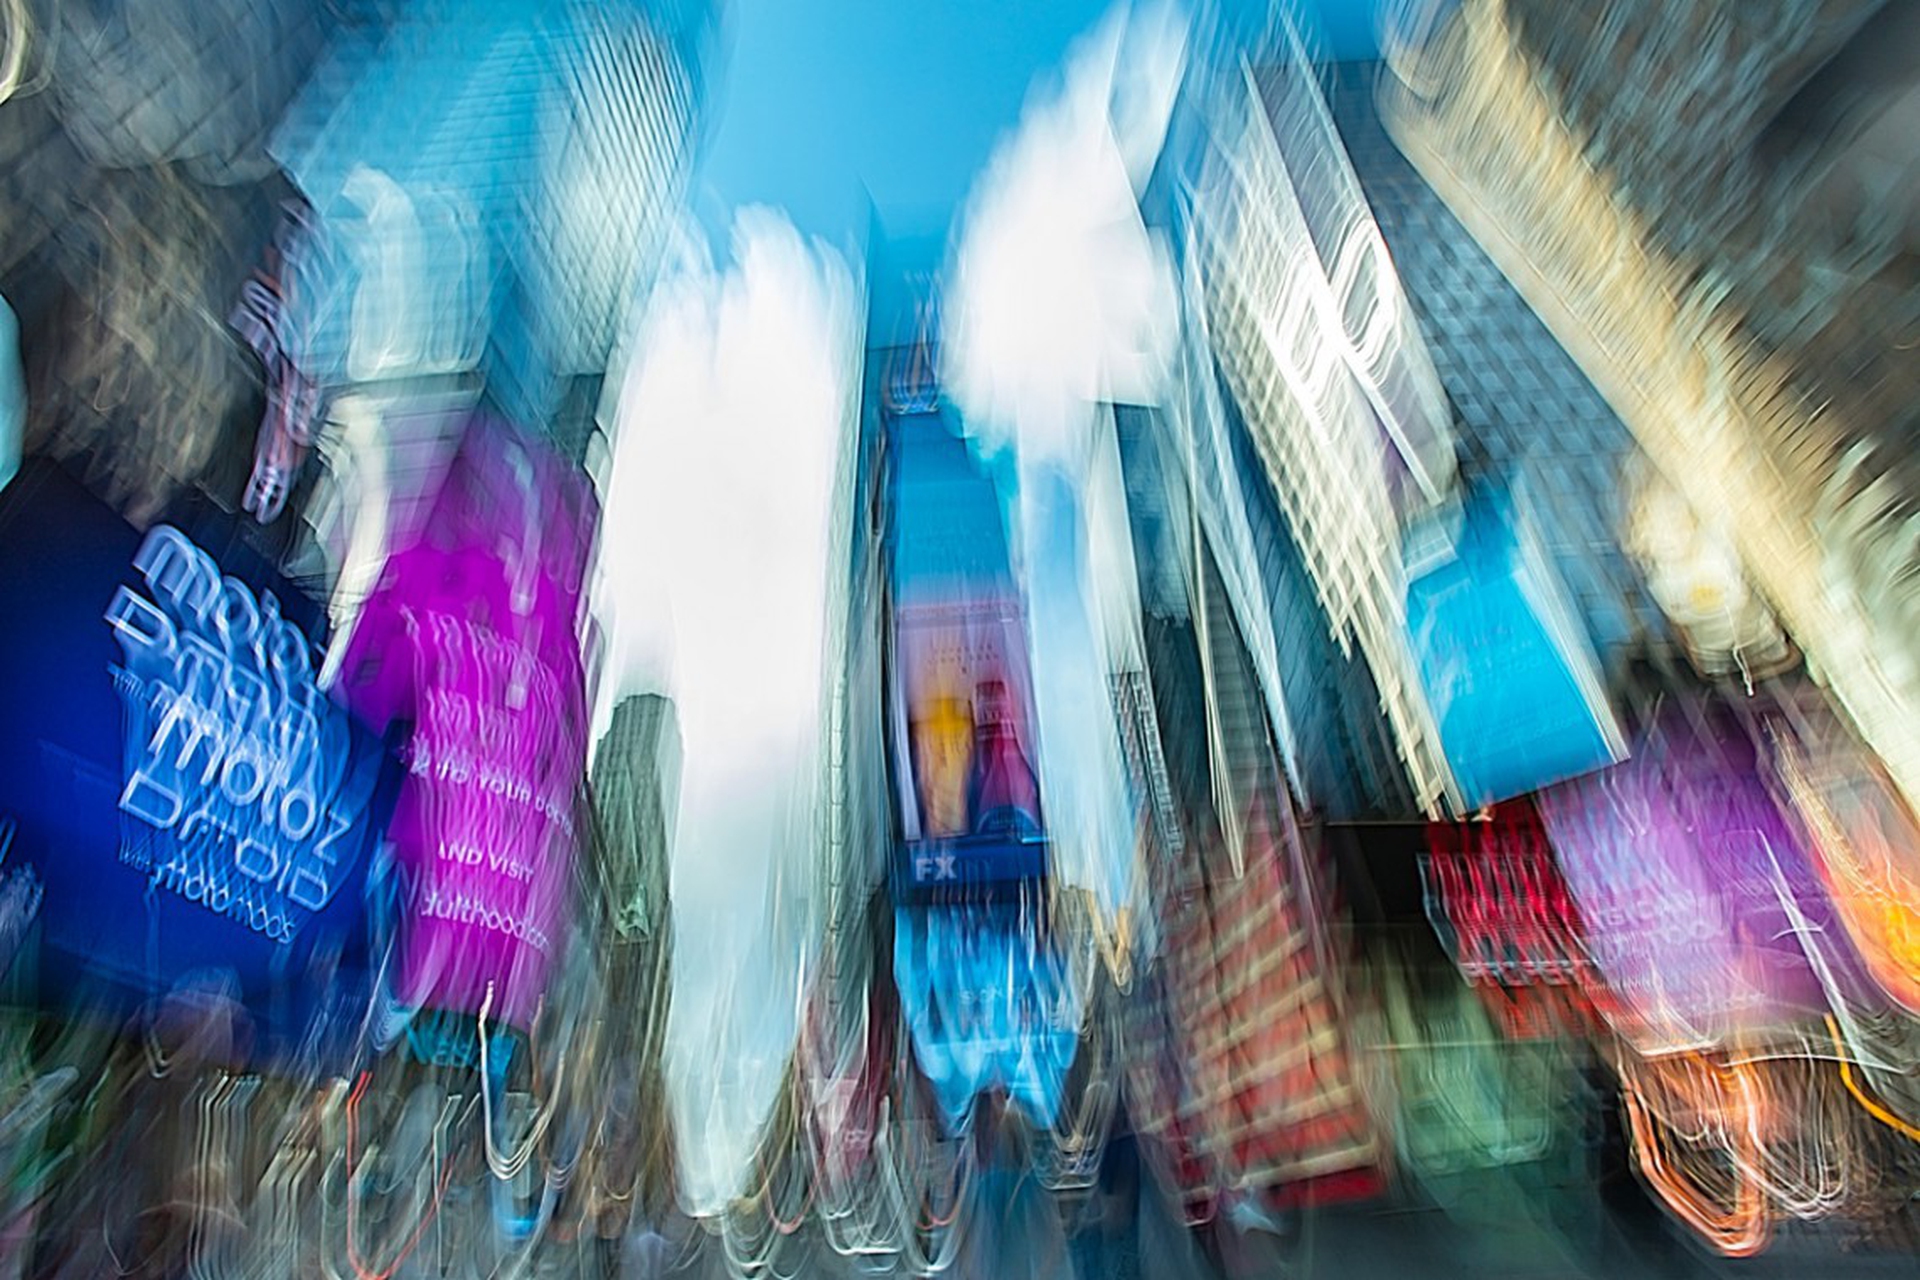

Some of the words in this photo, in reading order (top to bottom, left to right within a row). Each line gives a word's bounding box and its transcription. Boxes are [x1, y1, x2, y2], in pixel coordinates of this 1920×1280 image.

[438, 841, 482, 865] AND
[488, 850, 534, 884] VISIT
[916, 856, 957, 881] FX
